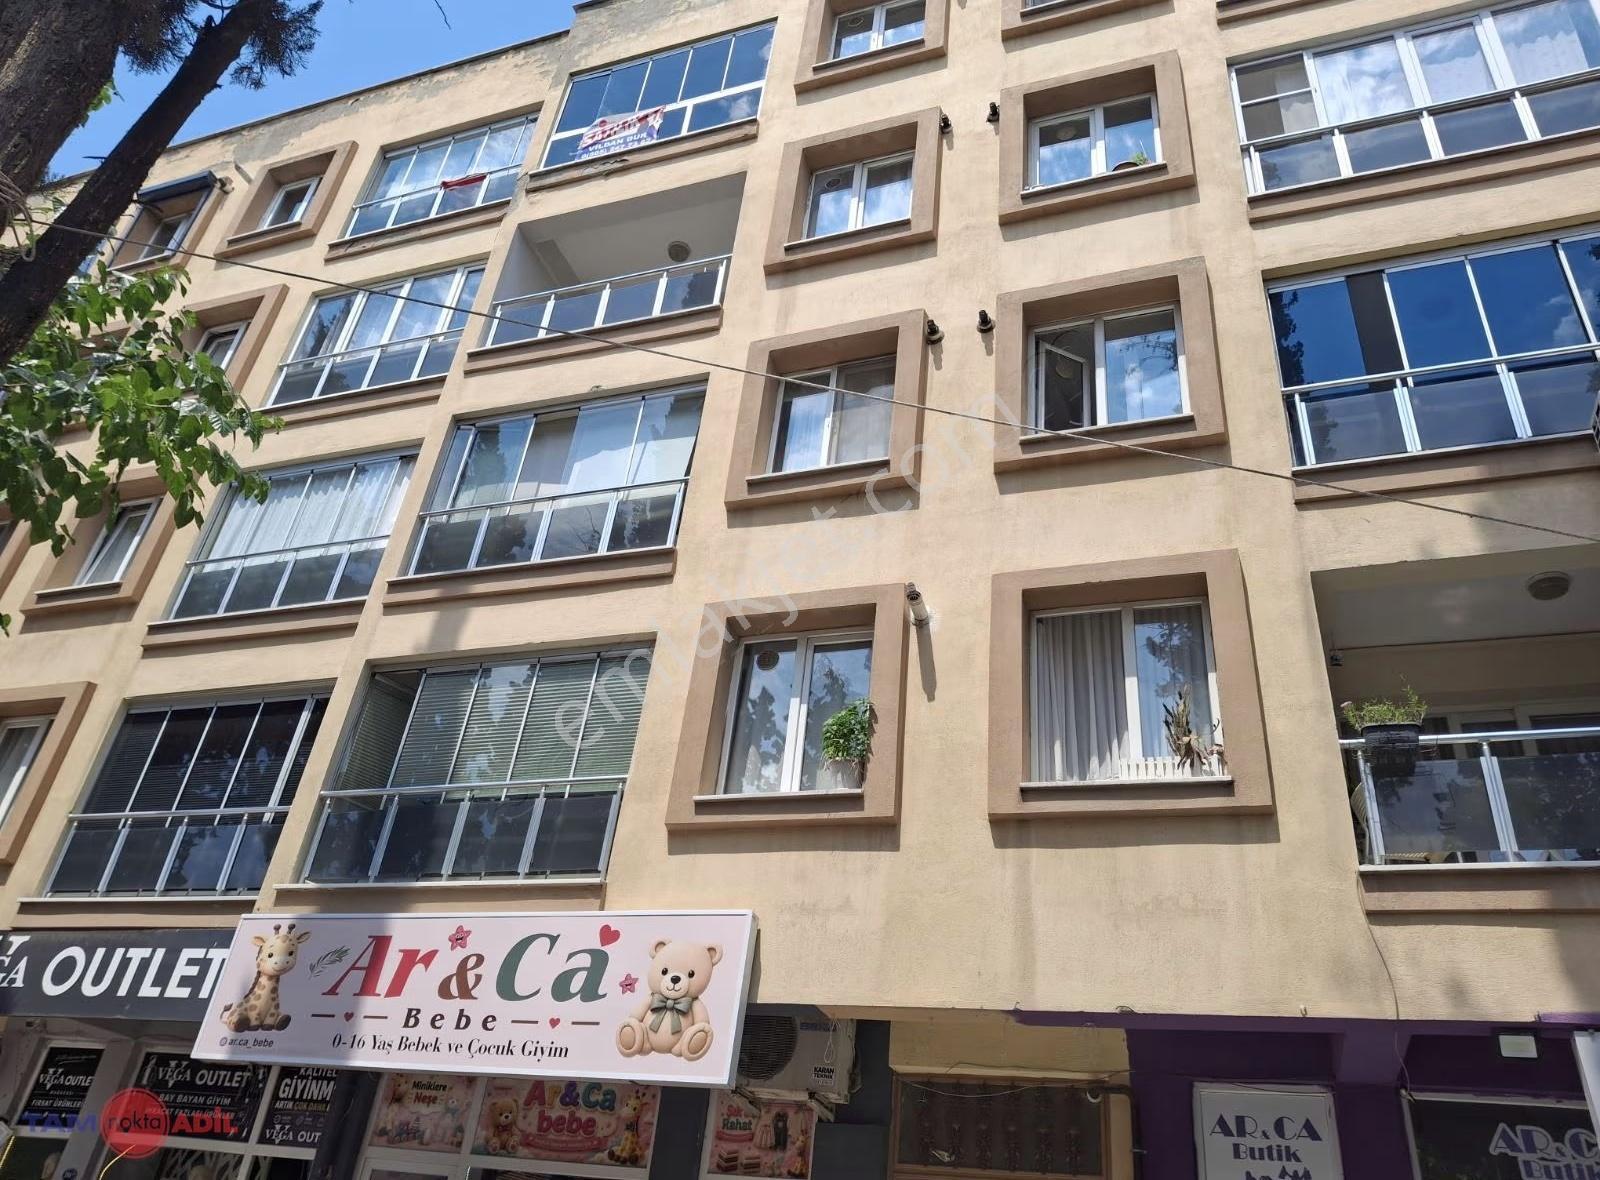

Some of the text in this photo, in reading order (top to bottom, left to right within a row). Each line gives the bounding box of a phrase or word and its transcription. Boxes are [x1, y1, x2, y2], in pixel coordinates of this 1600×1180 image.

[42, 946, 227, 999] OUTLET
[402, 1007, 497, 1031] Bebe
[332, 1034, 569, 1062] 0-16 Yaş Bebek ve Çocuk Giyim
[195, 1069, 251, 1088] OUTLET
[279, 1075, 337, 1101] GİYİNM
[176, 1094, 205, 1105] BAYAN
[206, 1095, 232, 1106] GİYİM
[536, 1111, 597, 1135] bebe
[1232, 1143, 1303, 1163] Butik
